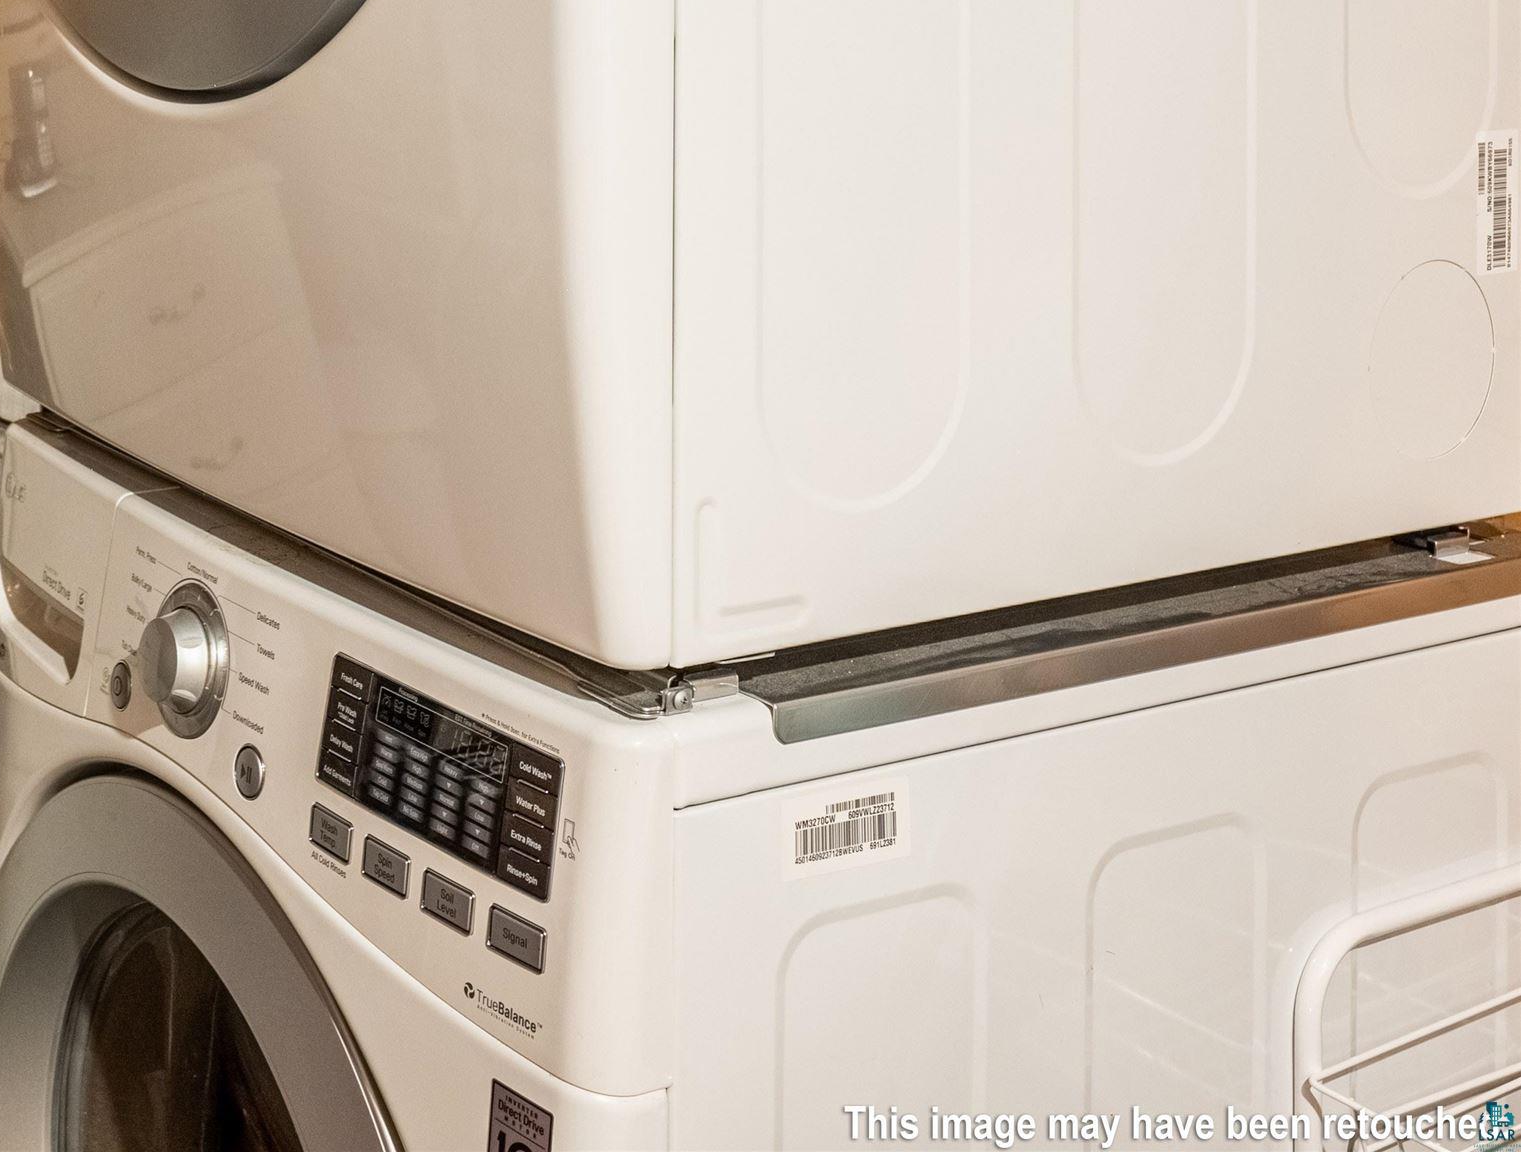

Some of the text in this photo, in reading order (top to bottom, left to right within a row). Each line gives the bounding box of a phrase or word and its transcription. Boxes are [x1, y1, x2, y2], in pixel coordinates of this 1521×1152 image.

[256, 611, 281, 630] Delicates
[256, 643, 276, 660] Towels
[238, 672, 270, 696] Speed Wash
[232, 710, 265, 735] Downloaded
[519, 761, 532, 775] Cold
[515, 795, 546, 818] Water Plus
[320, 817, 338, 835] Wash
[795, 814, 836, 830] WM3270CW
[510, 829, 542, 852] Extra Rinse
[311, 850, 319, 860] All
[318, 854, 330, 868] Cold
[377, 853, 392, 868] Spin
[374, 864, 395, 884] Speed
[506, 863, 538, 887] Rinse+Spin
[440, 887, 455, 904] Soil
[436, 898, 457, 919] Level
[502, 927, 528, 950] Signal
[505, 1094, 539, 1119] INVERTER
[498, 1098, 545, 1137] Direct Drive
